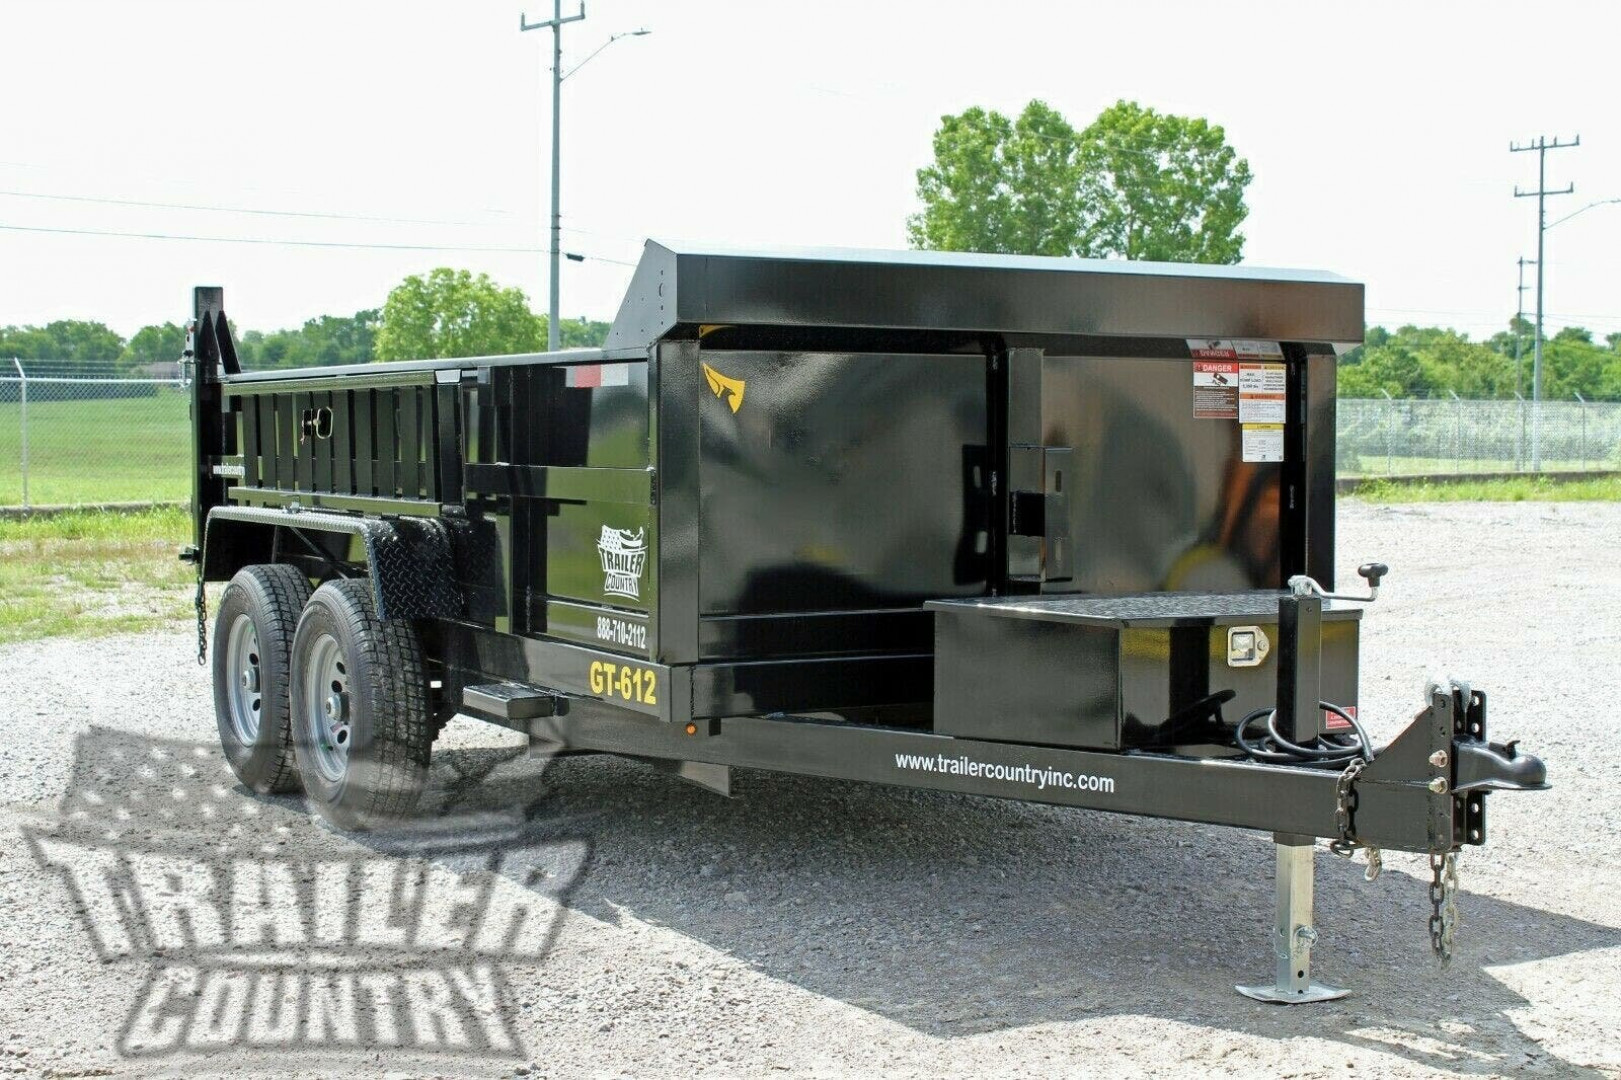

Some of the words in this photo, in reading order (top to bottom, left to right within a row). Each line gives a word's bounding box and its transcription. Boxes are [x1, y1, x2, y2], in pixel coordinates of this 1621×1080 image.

[1203, 364, 1232, 372] DANGER
[599, 548, 645, 577] TRAILER
[605, 574, 638, 596] COUNTRY
[597, 616, 646, 650] 888-710-2112
[590, 661, 657, 705] GT-612
[895, 753, 1115, 793] www.trailercountryinc.com
